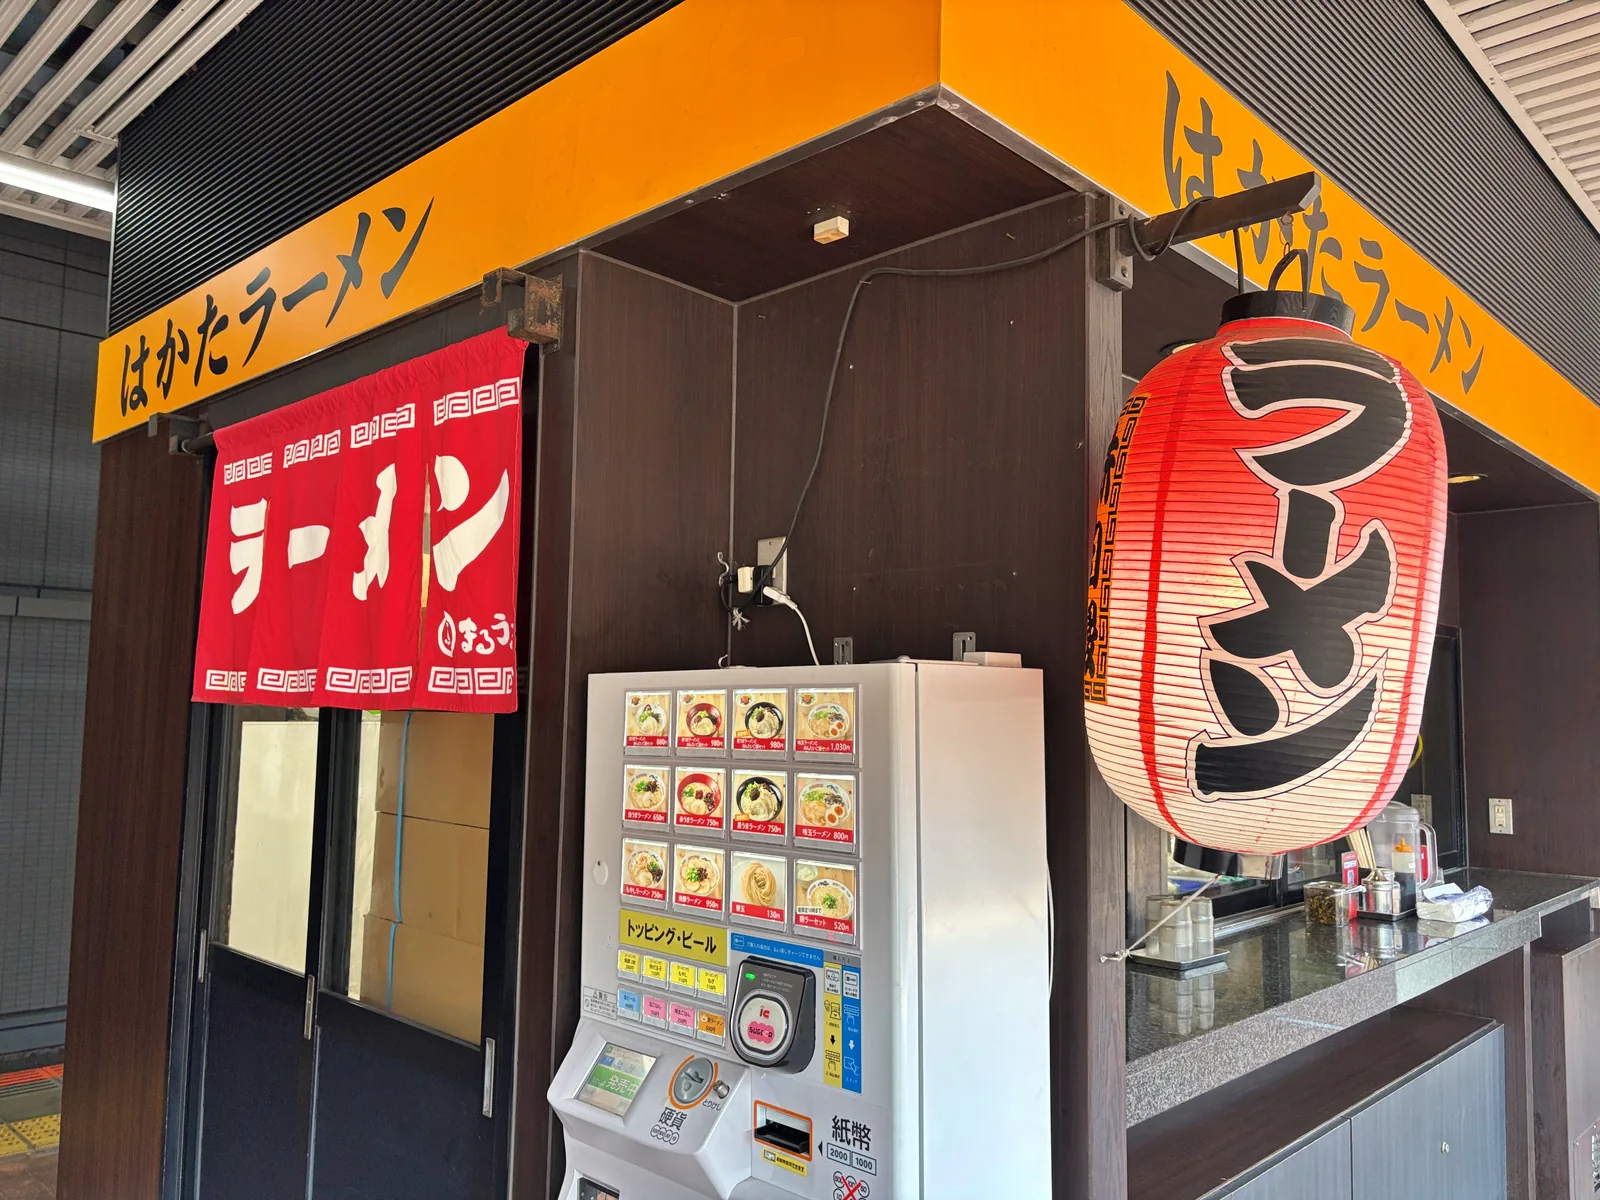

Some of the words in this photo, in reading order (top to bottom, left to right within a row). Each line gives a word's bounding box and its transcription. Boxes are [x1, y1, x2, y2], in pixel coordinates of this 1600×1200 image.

[121, 196, 435, 417] はかたラーメン
[229, 454, 509, 615] ラーメン
[1187, 336, 1412, 802] ラーメン
[830, 743, 850, 751] 1,030円
[706, 818, 719, 827] 750円
[767, 825, 781, 833] 750円
[833, 832, 849, 840] 800円
[651, 890, 663, 899] 750円
[705, 900, 719, 909] 950円
[766, 910, 781, 919] 130円
[833, 921, 849, 931] 520円
[627, 918, 717, 954] トッピング・ビール
[702, 1098, 722, 1111] とりけし
[657, 1106, 688, 1131] 硬貨
[831, 1115, 872, 1152] 紙幣
[830, 1148, 848, 1162] 2000
[855, 1157, 873, 1170] 1000
